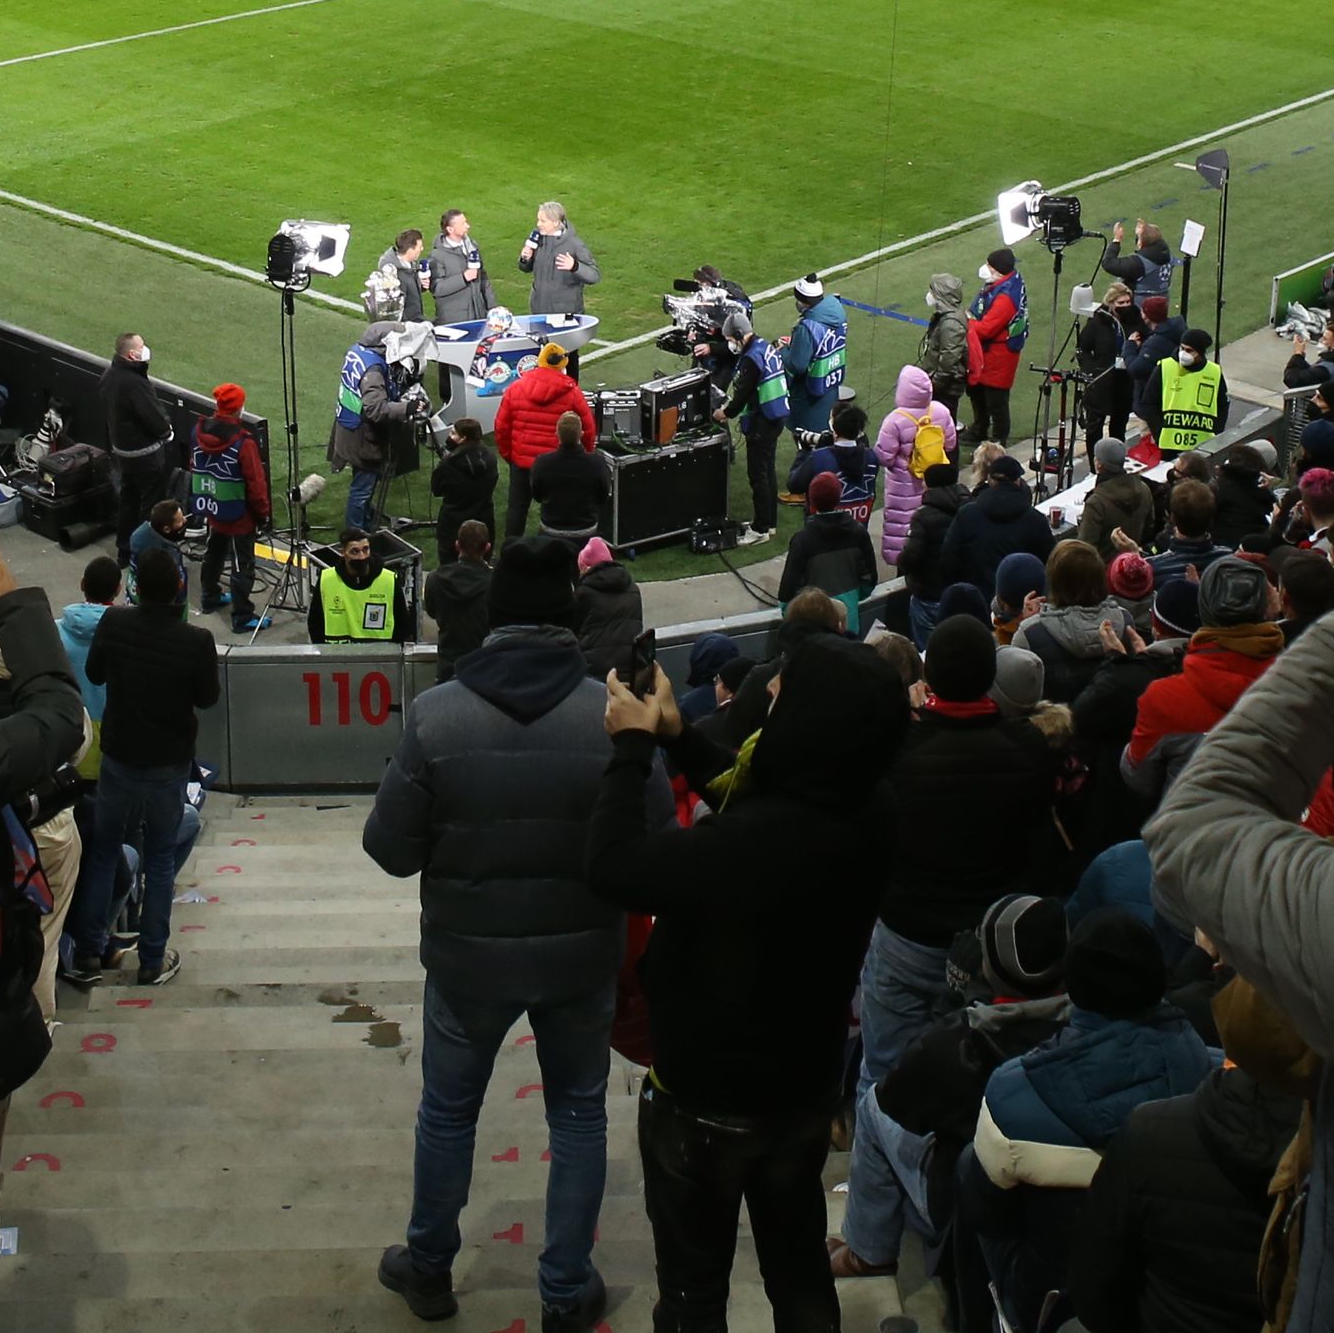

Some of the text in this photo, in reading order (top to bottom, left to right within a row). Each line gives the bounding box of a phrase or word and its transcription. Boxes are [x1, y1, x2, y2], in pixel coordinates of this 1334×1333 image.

[828, 355, 841, 370] HB
[825, 369, 843, 388] 037
[1174, 432, 1198, 445] 085
[201, 478, 216, 494] HB
[302, 671, 392, 726] 110
